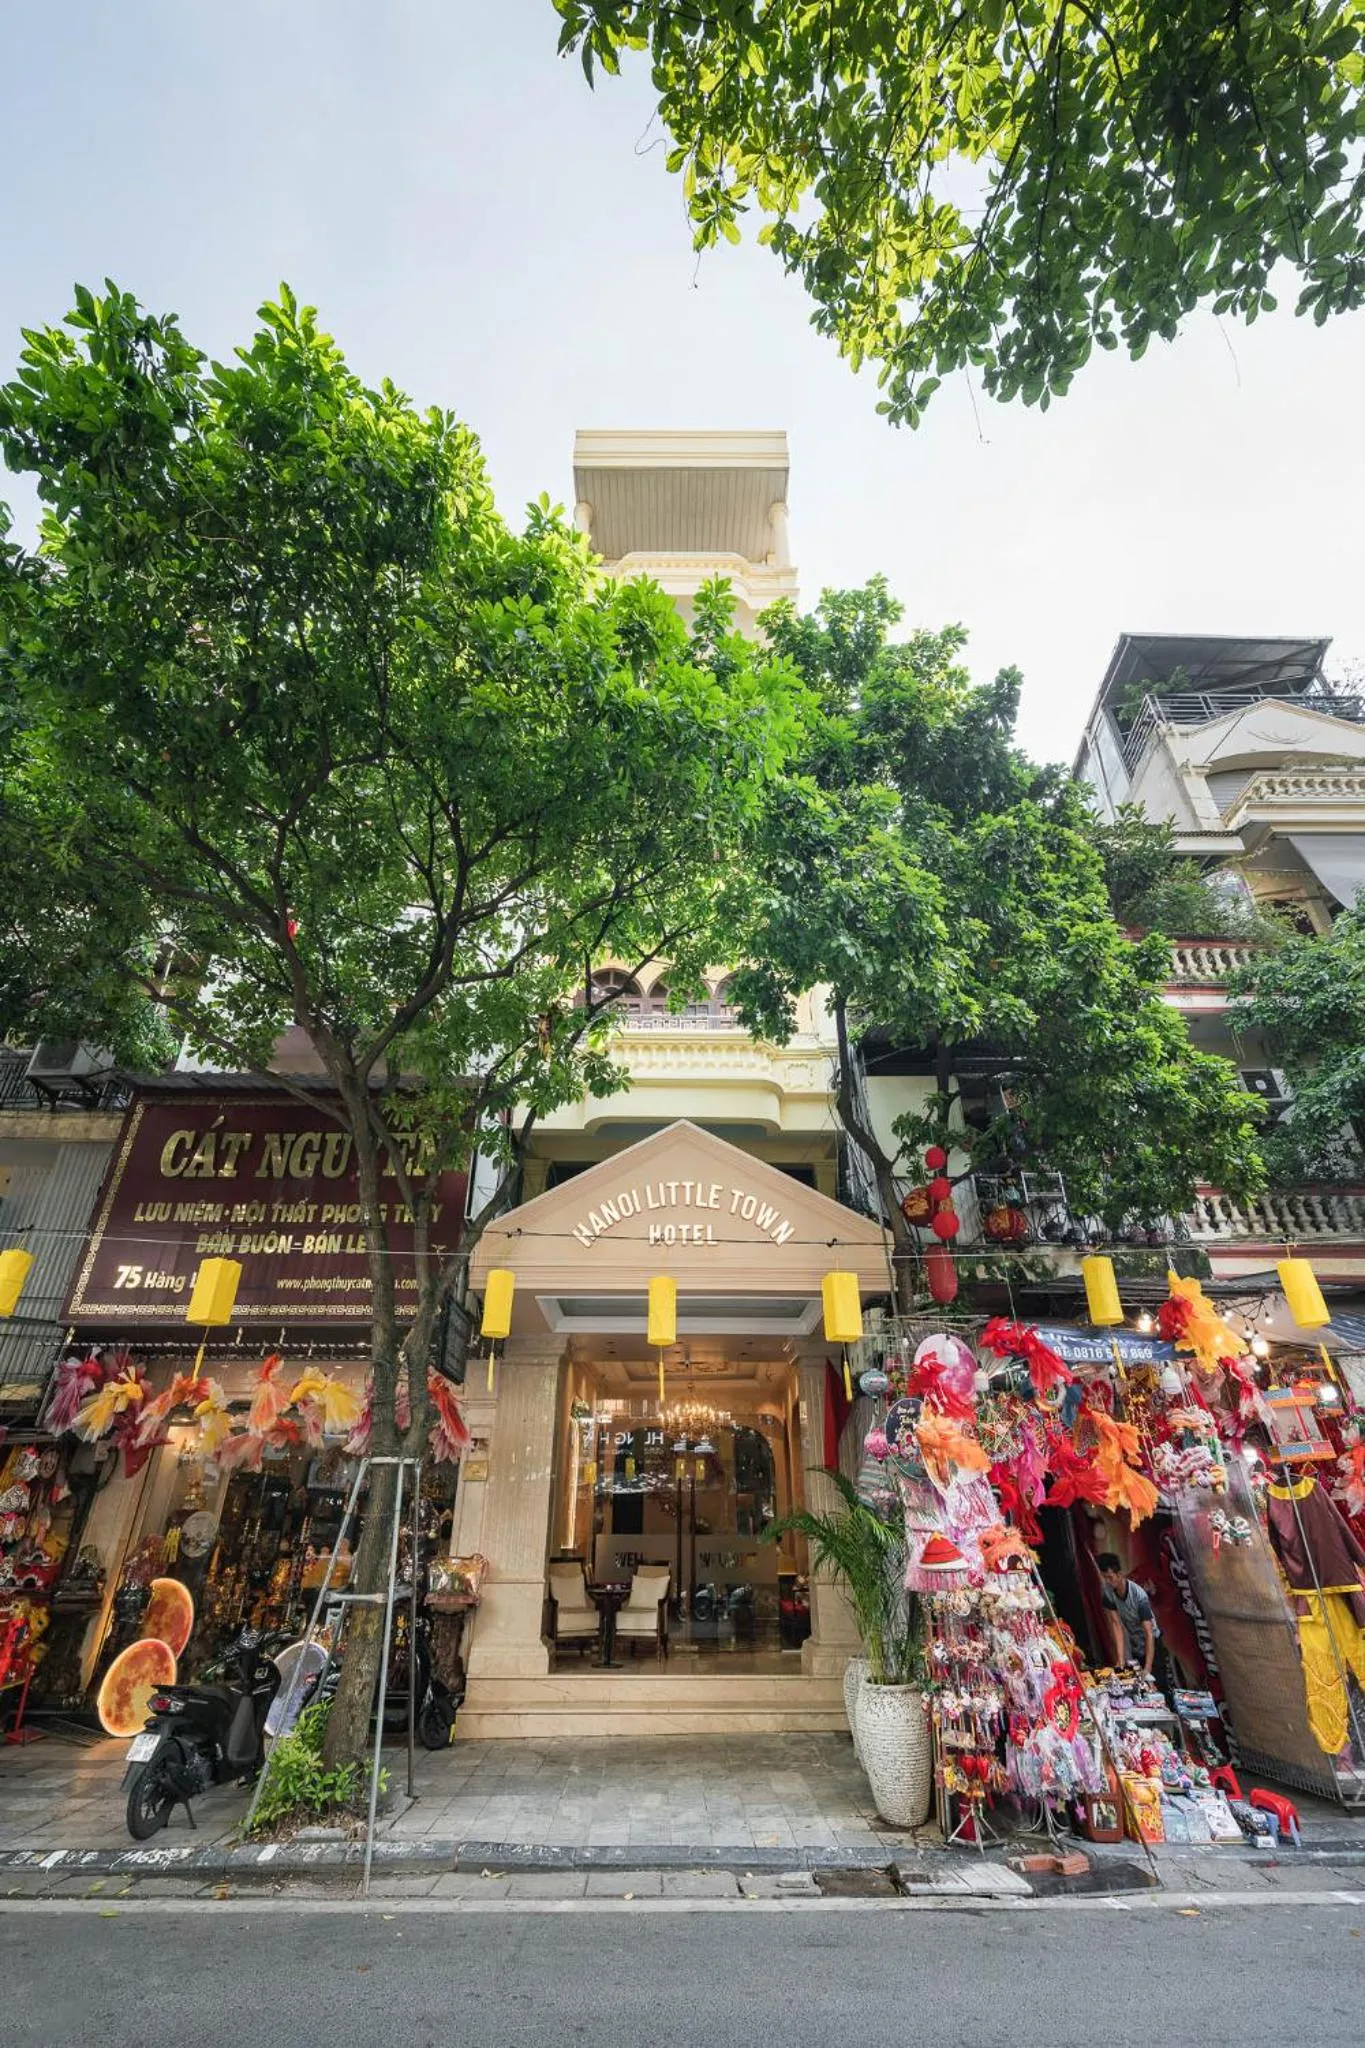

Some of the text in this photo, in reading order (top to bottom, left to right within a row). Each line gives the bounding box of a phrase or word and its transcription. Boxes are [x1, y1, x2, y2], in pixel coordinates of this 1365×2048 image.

[160, 1114, 252, 1178] CÁT
[572, 1181, 795, 1248] HANOI LITTLE TOWN
[648, 1223, 719, 1246] HOTEL
[113, 1265, 143, 1289] 75
[144, 1270, 187, 1293] Hàng
